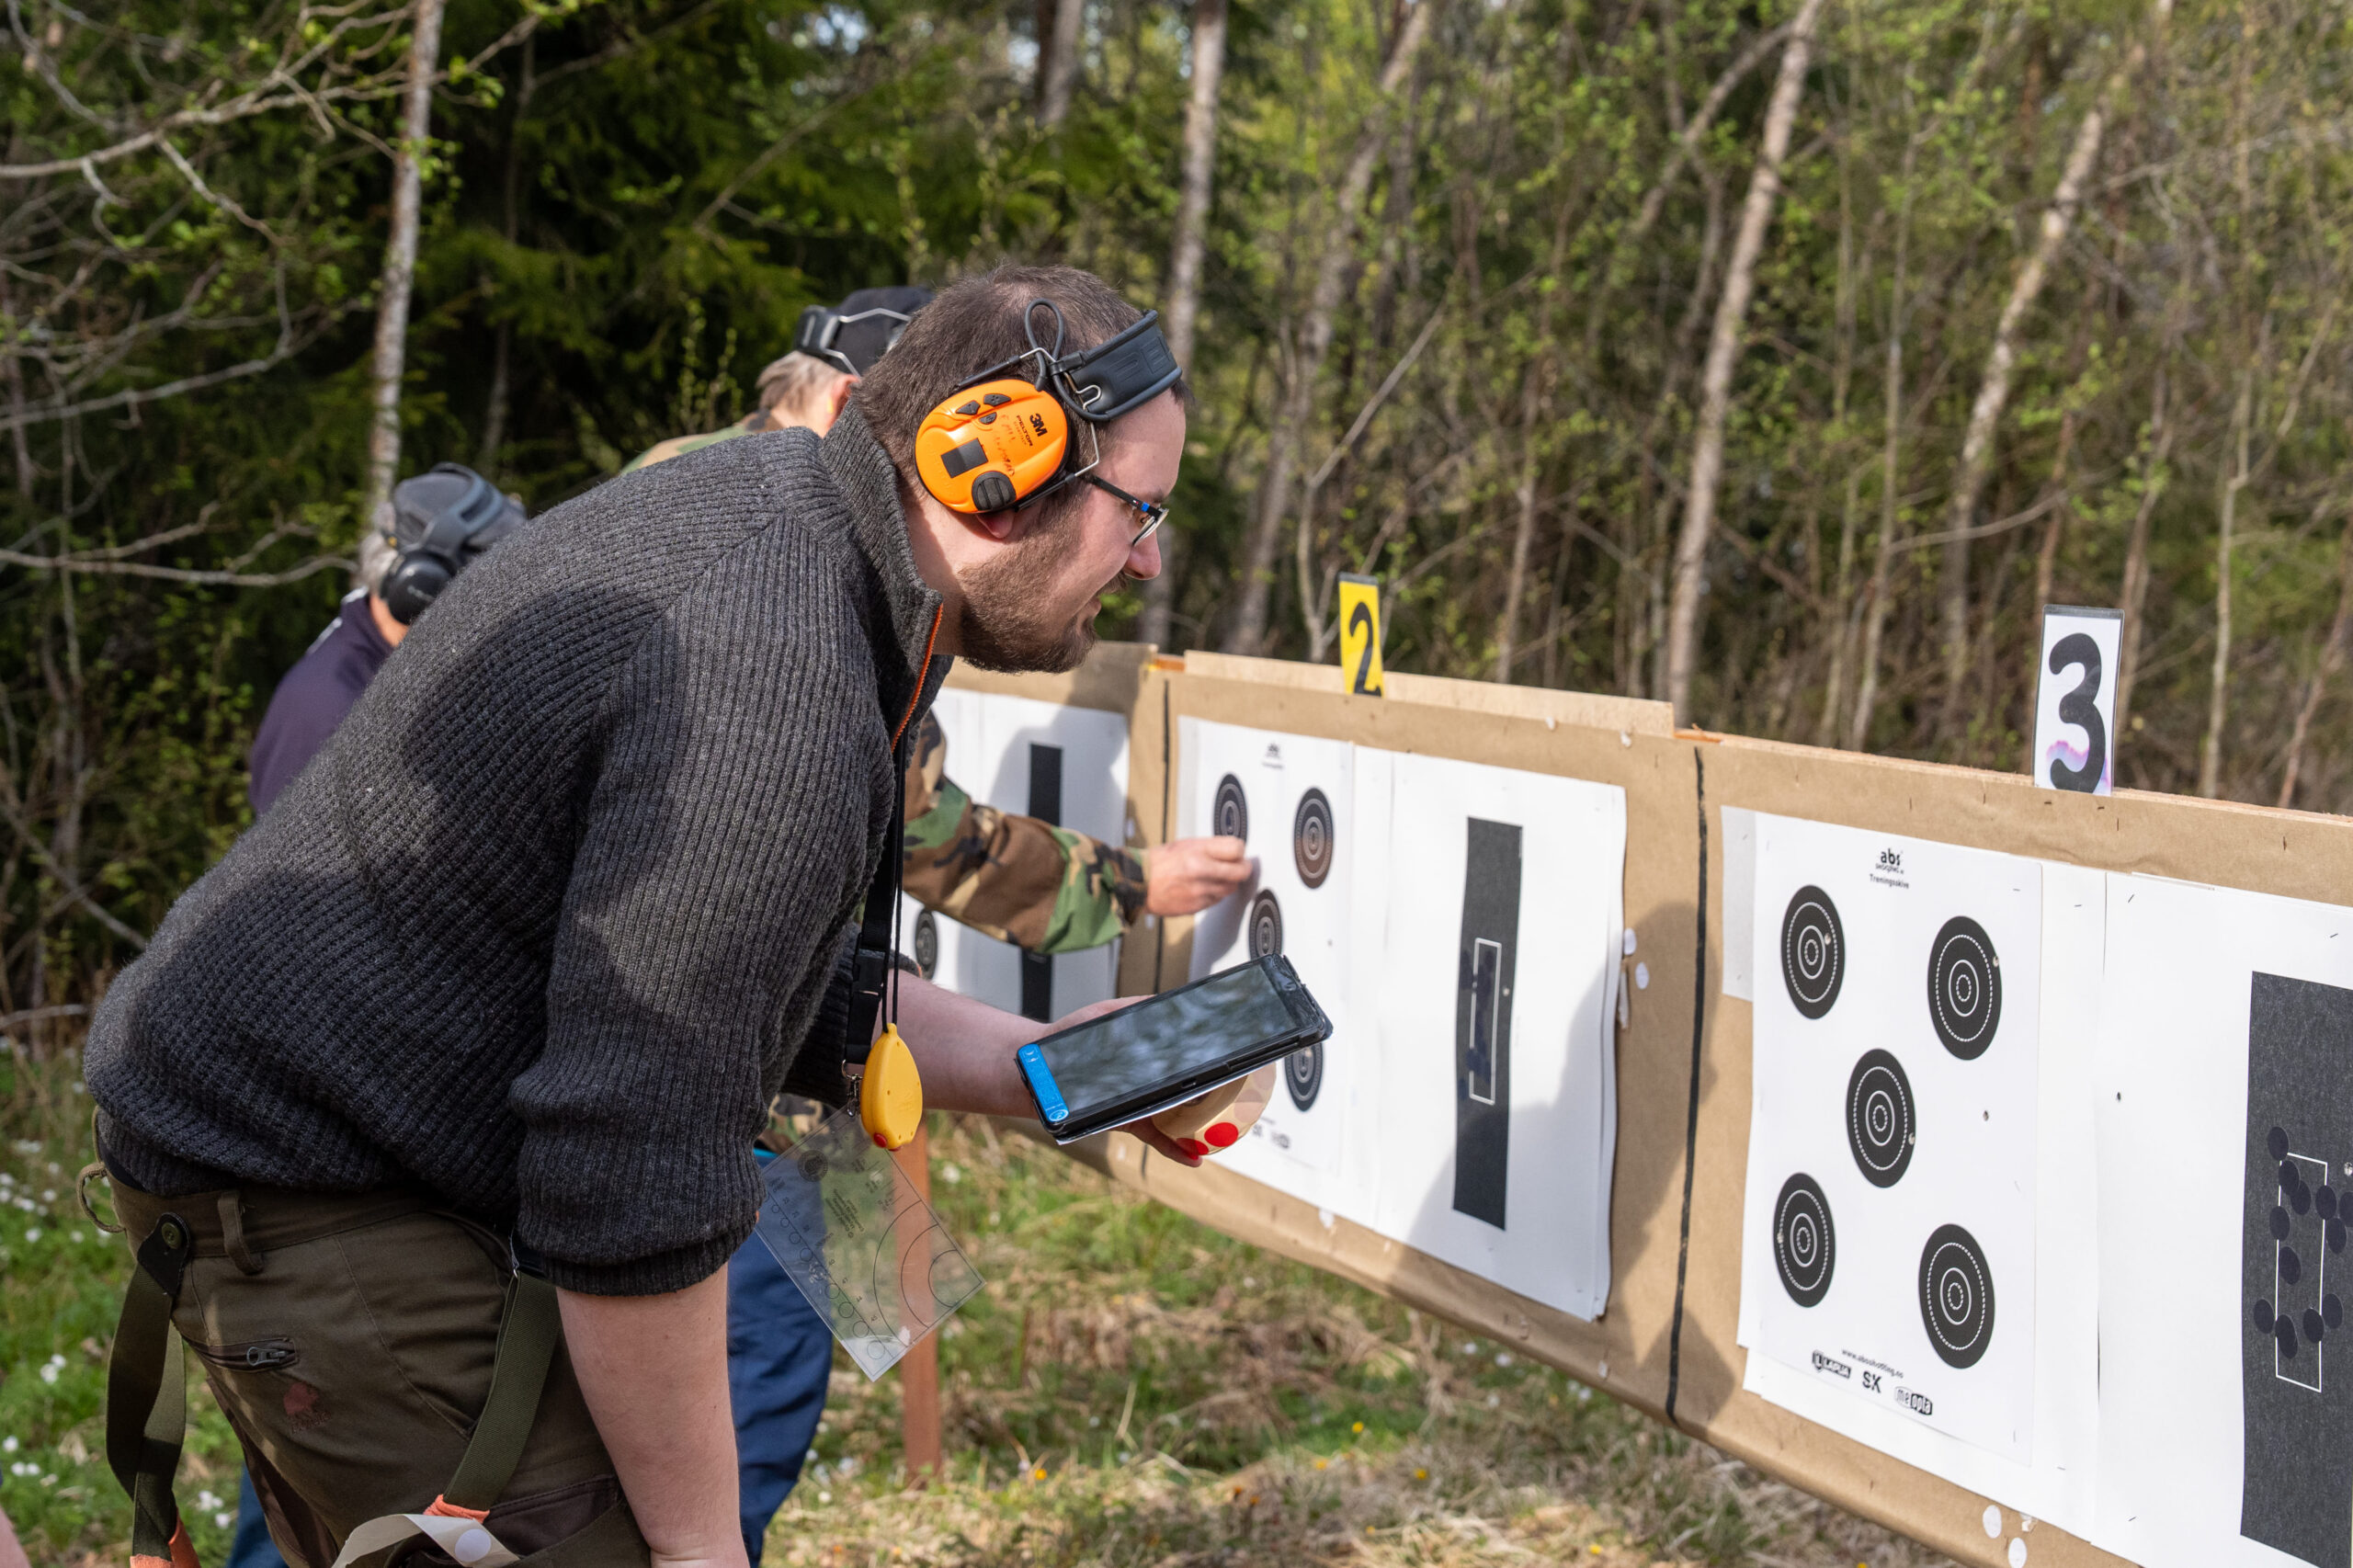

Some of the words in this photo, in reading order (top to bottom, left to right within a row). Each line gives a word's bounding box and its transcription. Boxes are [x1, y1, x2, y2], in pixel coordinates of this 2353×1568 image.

[1016, 415, 1033, 447] PELTOR
[1029, 413, 1048, 437] 3M
[1349, 601, 1382, 698] 2
[2049, 632, 2107, 794] 3
[1880, 847, 1901, 866] abs
[1862, 1370, 1882, 1394] SX
